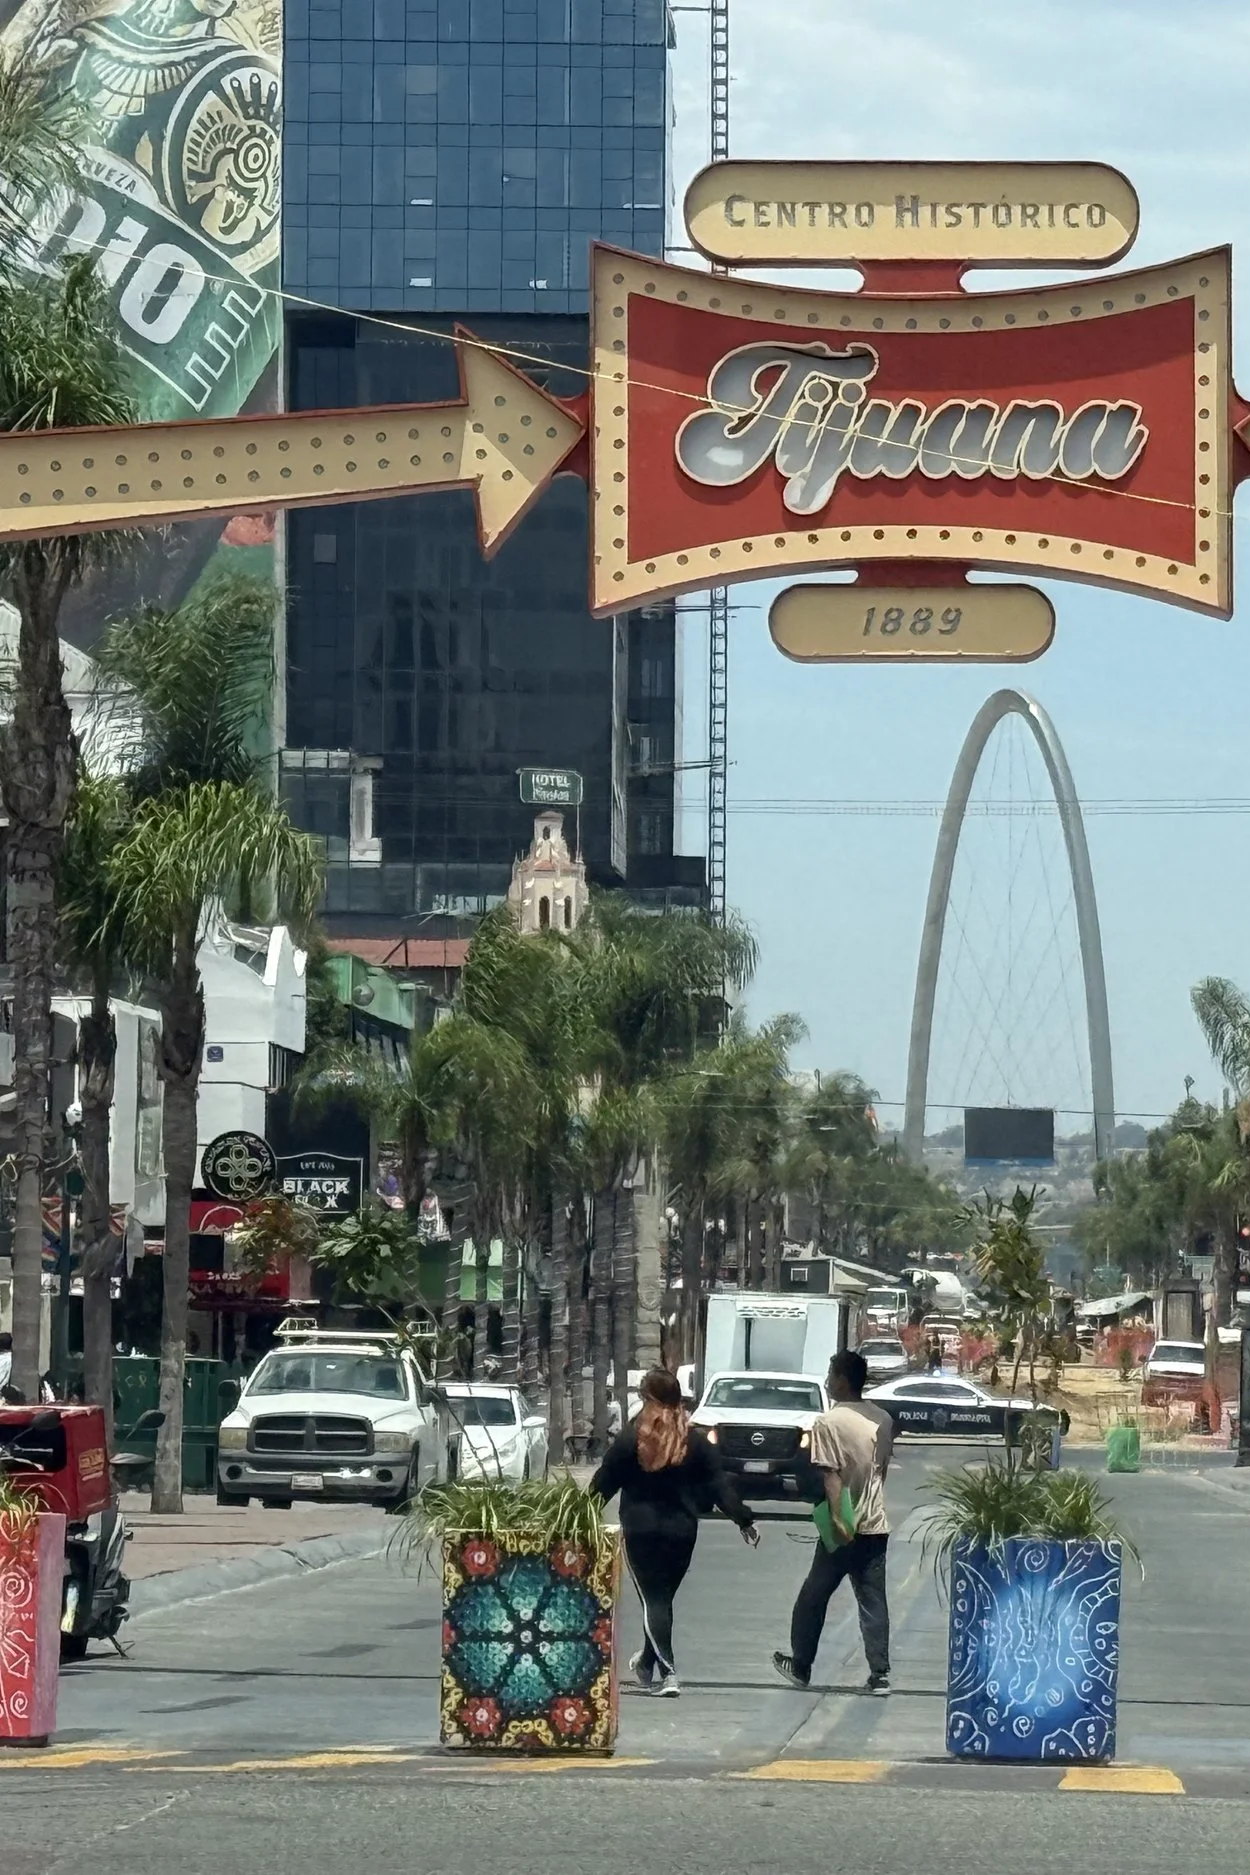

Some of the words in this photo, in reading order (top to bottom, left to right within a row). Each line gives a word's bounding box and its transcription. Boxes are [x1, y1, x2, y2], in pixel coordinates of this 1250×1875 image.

[723, 193, 876, 229] CENTRO
[894, 193, 1107, 229] HISTÓRICO
[675, 341, 1149, 515] Tijuana
[862, 606, 963, 636] 1889
[283, 1178, 350, 1195] BLACK
